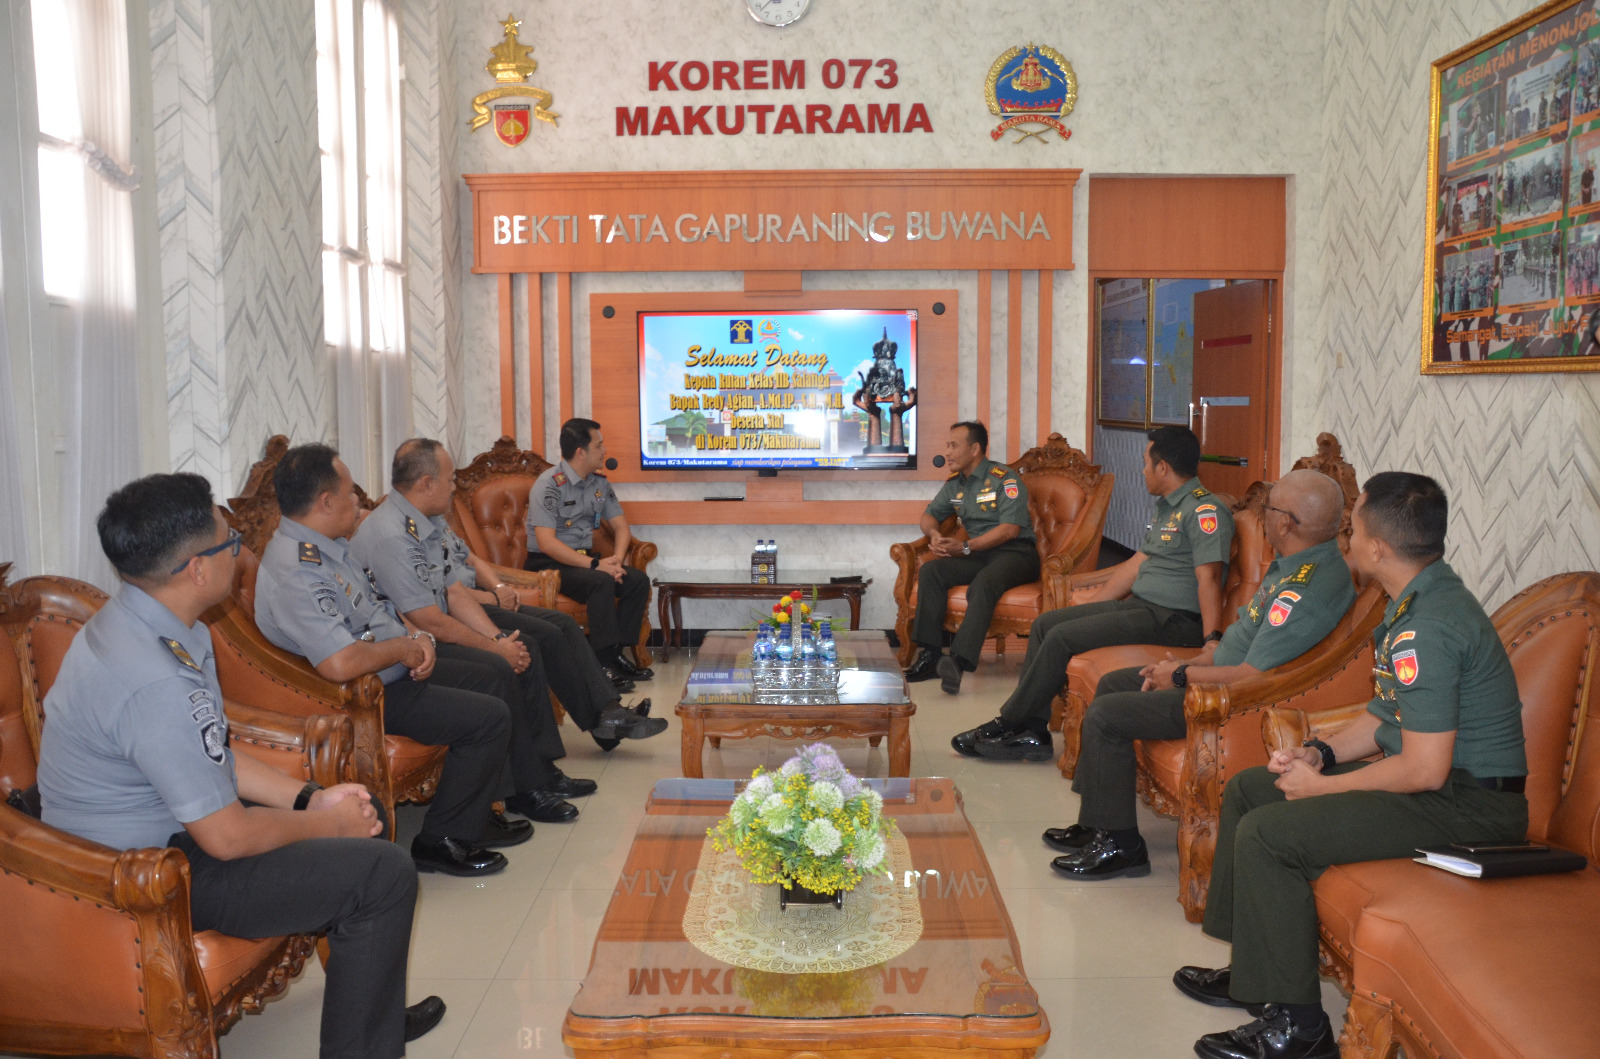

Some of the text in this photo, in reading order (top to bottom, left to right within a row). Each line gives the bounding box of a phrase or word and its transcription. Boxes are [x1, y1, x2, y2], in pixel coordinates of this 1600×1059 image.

[1456, 50, 1516, 89] KEGIATAN
[1519, 7, 1600, 60] MENONJOL
[648, 58, 899, 92] KOREM 073
[615, 102, 935, 137] MAKUTARAMA
[1001, 116, 1061, 129] MAKUTA RAMA
[493, 210, 1052, 245] BEKTI TATA GAPURANING BUWANA
[1446, 325, 1499, 345] Semangat,
[1501, 320, 1540, 342] Empati,
[685, 343, 828, 373] Selamat Datang
[684, 372, 831, 391] Kepala Rutan Kelas IIB Salatiga
[669, 393, 700, 412] Bapak
[702, 393, 725, 412] Redy
[727, 393, 757, 412] Agian,
[731, 413, 765, 429] beserta
[695, 433, 821, 450] di Korem 073/Makutarama
